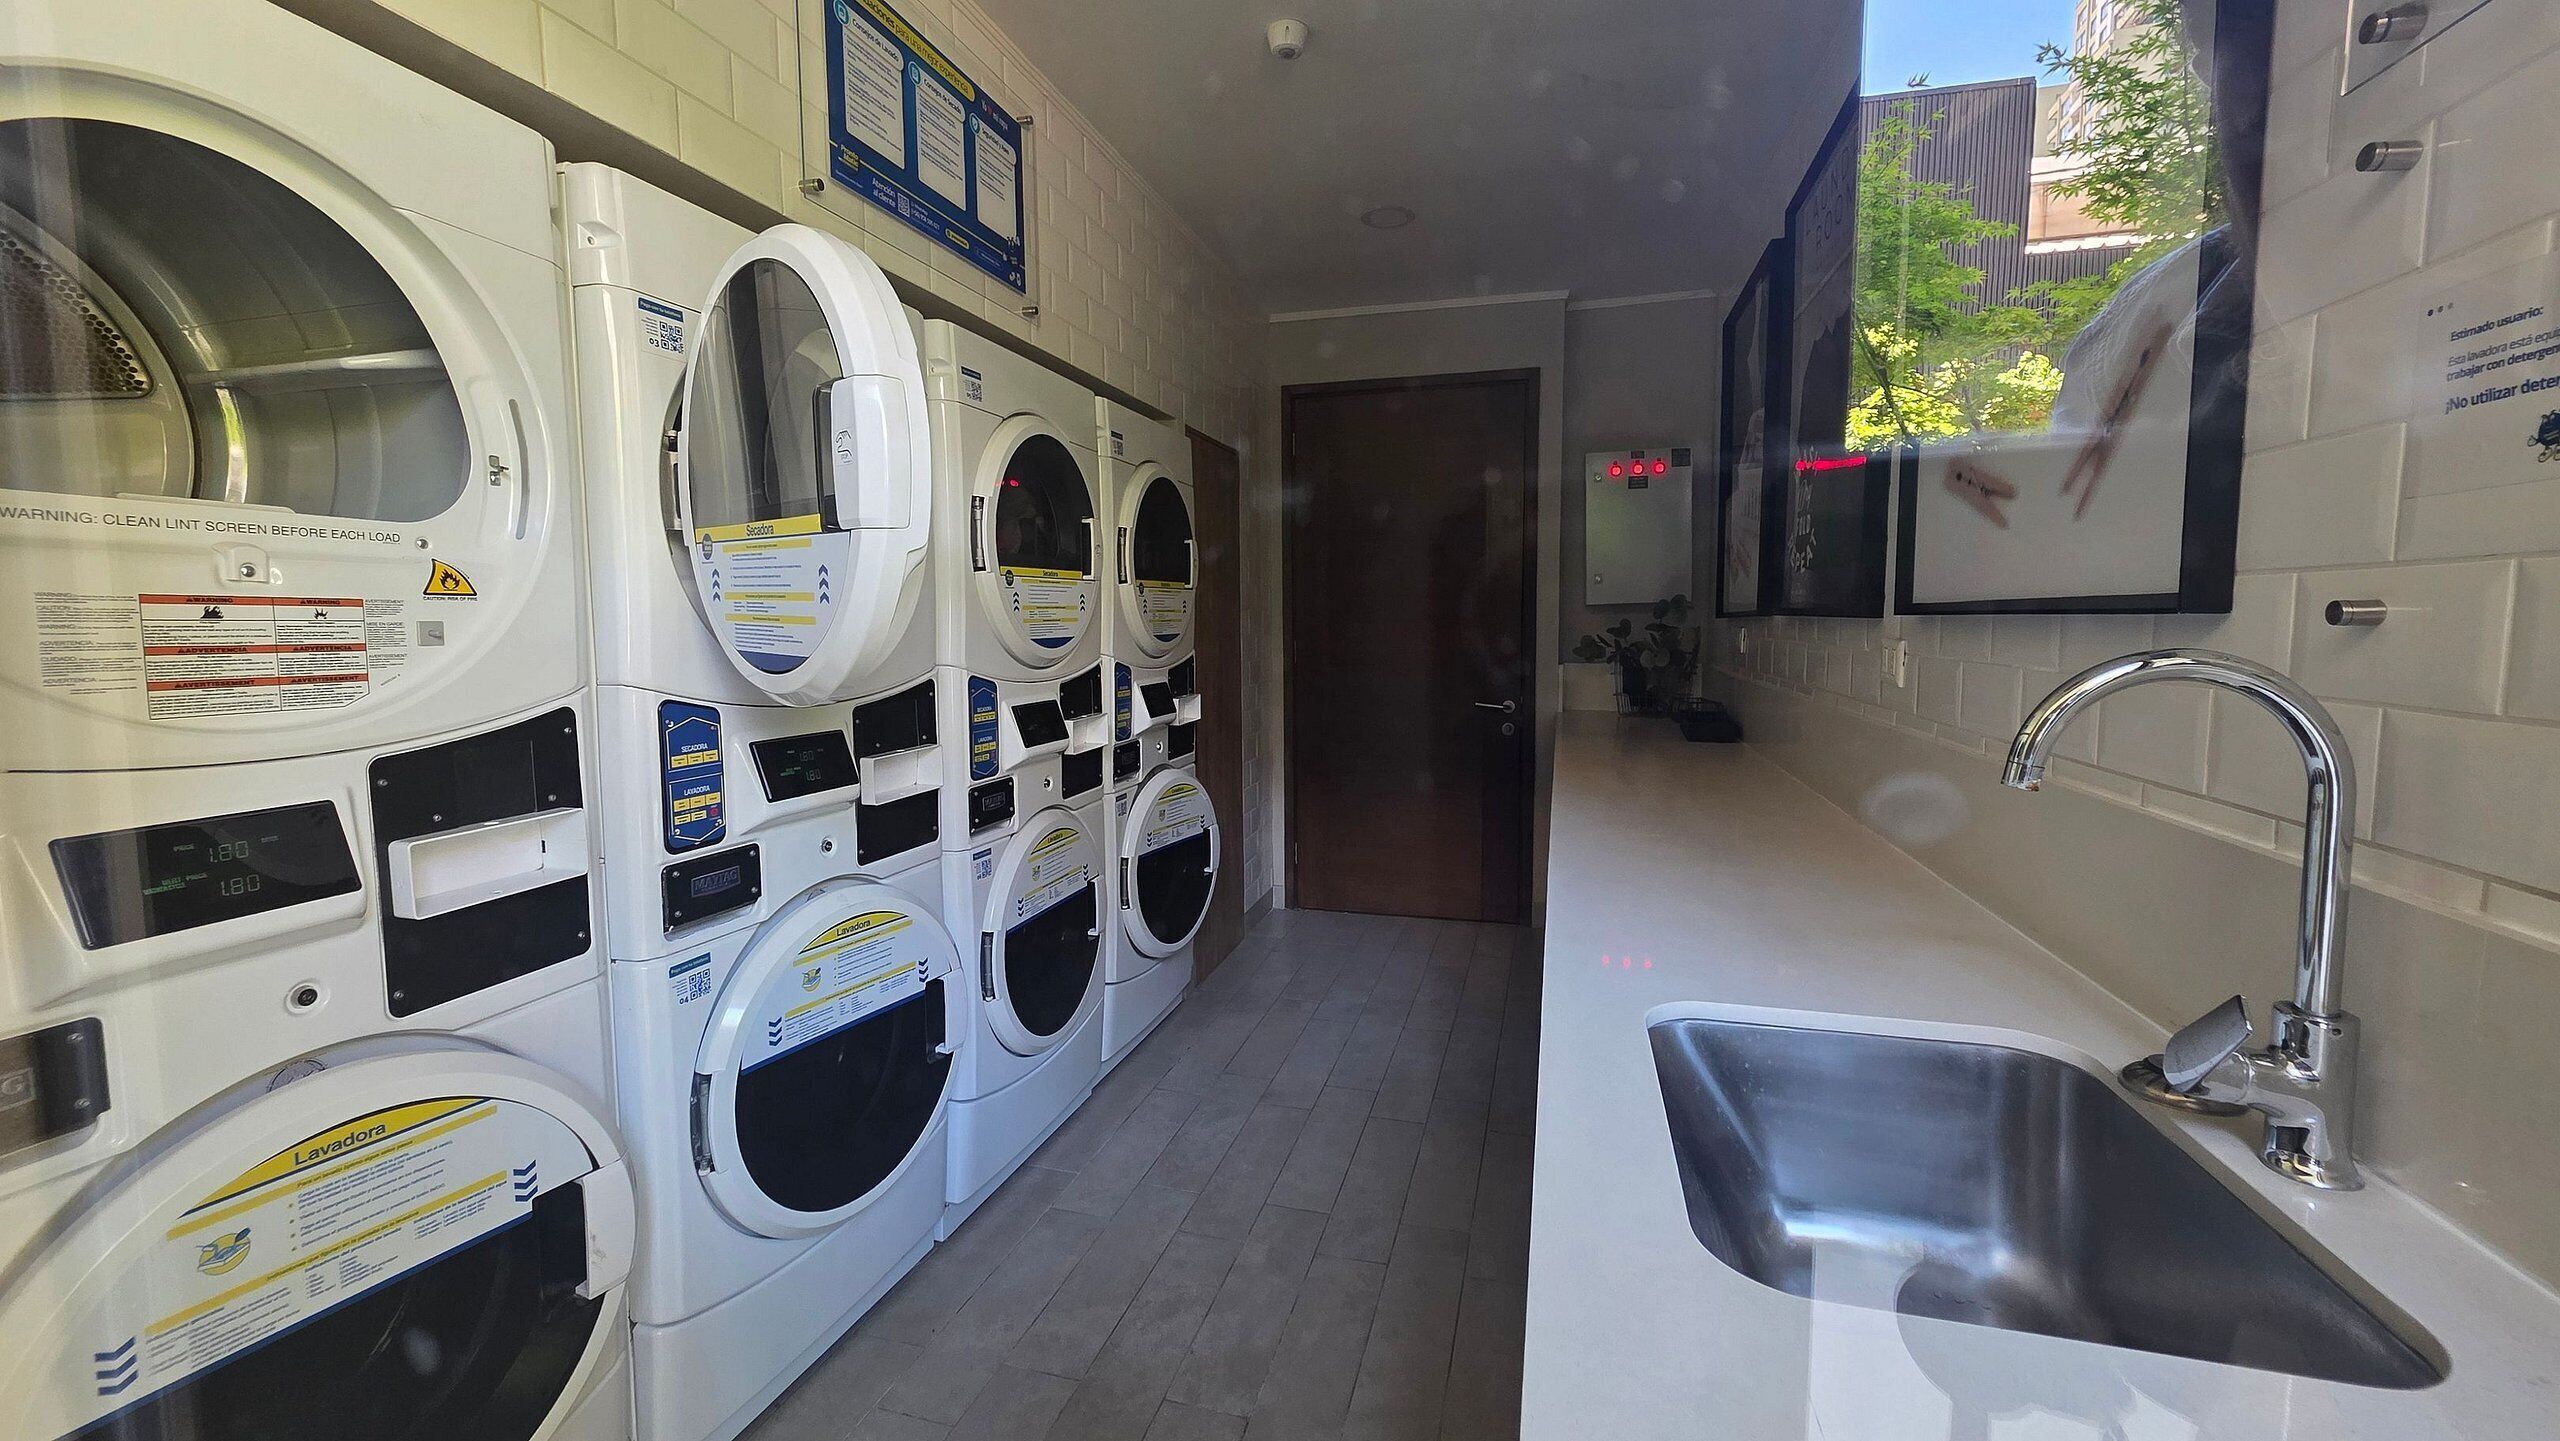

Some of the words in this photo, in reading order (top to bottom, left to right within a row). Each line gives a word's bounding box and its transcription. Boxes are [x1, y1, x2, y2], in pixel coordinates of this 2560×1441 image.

[872, 178, 896, 198] Atención
[878, 192, 897, 208] cliente
[2450, 320, 2495, 342] Estimado
[2496, 305, 2545, 328] usuario:
[648, 337, 660, 348] 03
[2448, 354, 2467, 368] Esta
[2466, 342, 2508, 363] lavadora
[2508, 332, 2533, 350] está
[2446, 363, 2486, 383] trabajar
[2485, 358, 2506, 371] con
[2507, 343, 2560, 366] detergen
[2444, 396, 2469, 415] ¡No
[2470, 383, 2519, 407] utilizar
[2520, 374, 2560, 395] deter
[0, 505, 100, 525] WARNING:
[102, 513, 161, 529] CLEAN
[165, 518, 201, 532] LINT
[204, 519, 268, 536] SCREEN
[271, 524, 328, 539] BEFORE
[330, 528, 366, 541] EACH
[368, 531, 402, 544] LOAD
[745, 523, 775, 537] Secadora
[184, 645, 249, 654] ADVERTENCIA
[181, 679, 256, 689] AVERTISSEMENT
[295, 675, 359, 684] AVERTISSEMENT
[681, 742, 709, 753] SECADORA
[683, 784, 711, 796] LAVADORA
[836, 919, 871, 938] Lavadora
[679, 996, 690, 1005] 04
[294, 1122, 386, 1166] Lavadora
